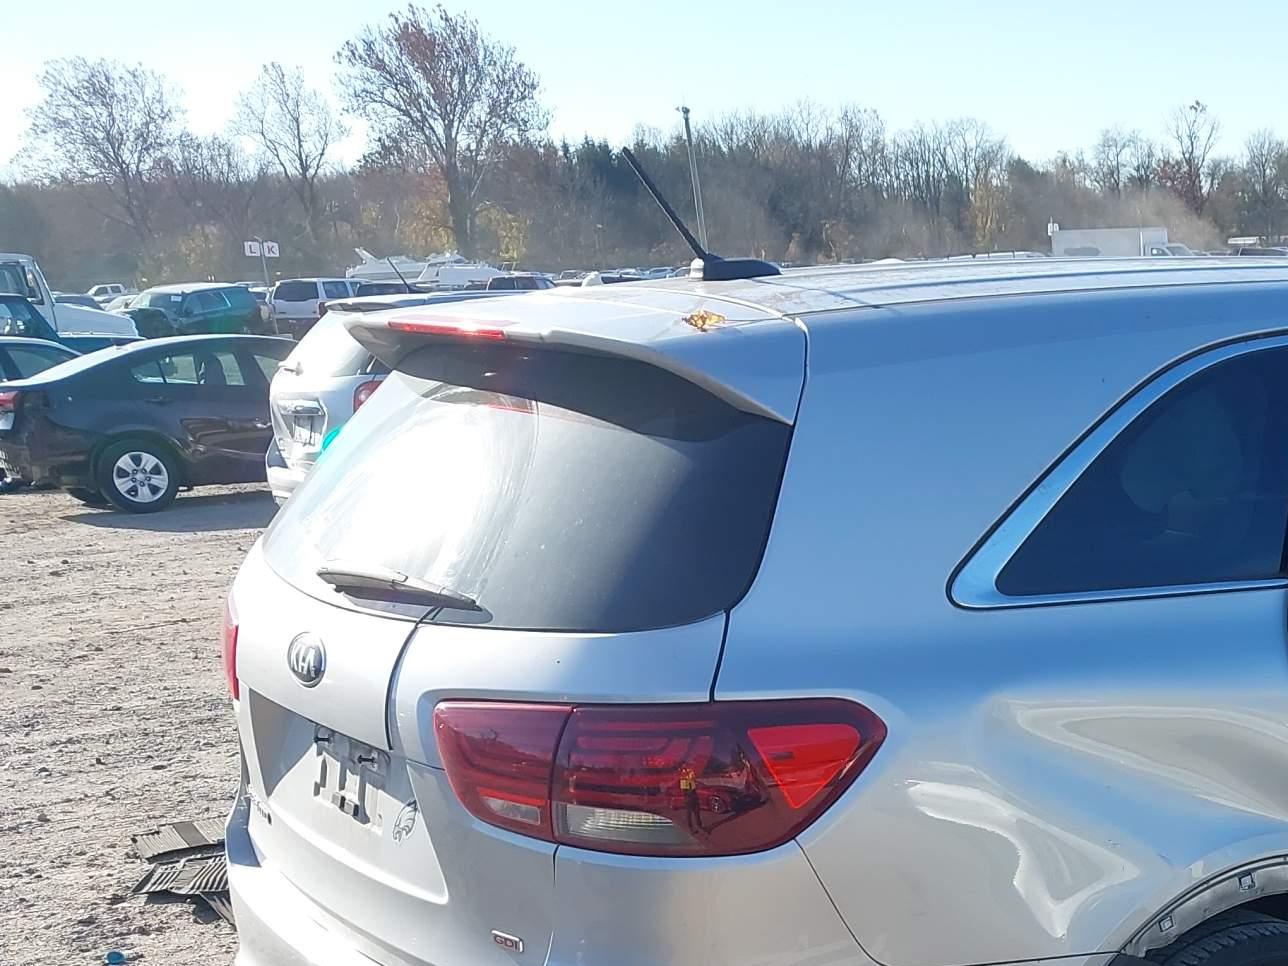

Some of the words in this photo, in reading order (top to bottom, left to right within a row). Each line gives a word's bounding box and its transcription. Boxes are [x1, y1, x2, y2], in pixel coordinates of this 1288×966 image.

[249, 244, 257, 255] L
[267, 244, 277, 255] K
[494, 934, 519, 950] GDI
